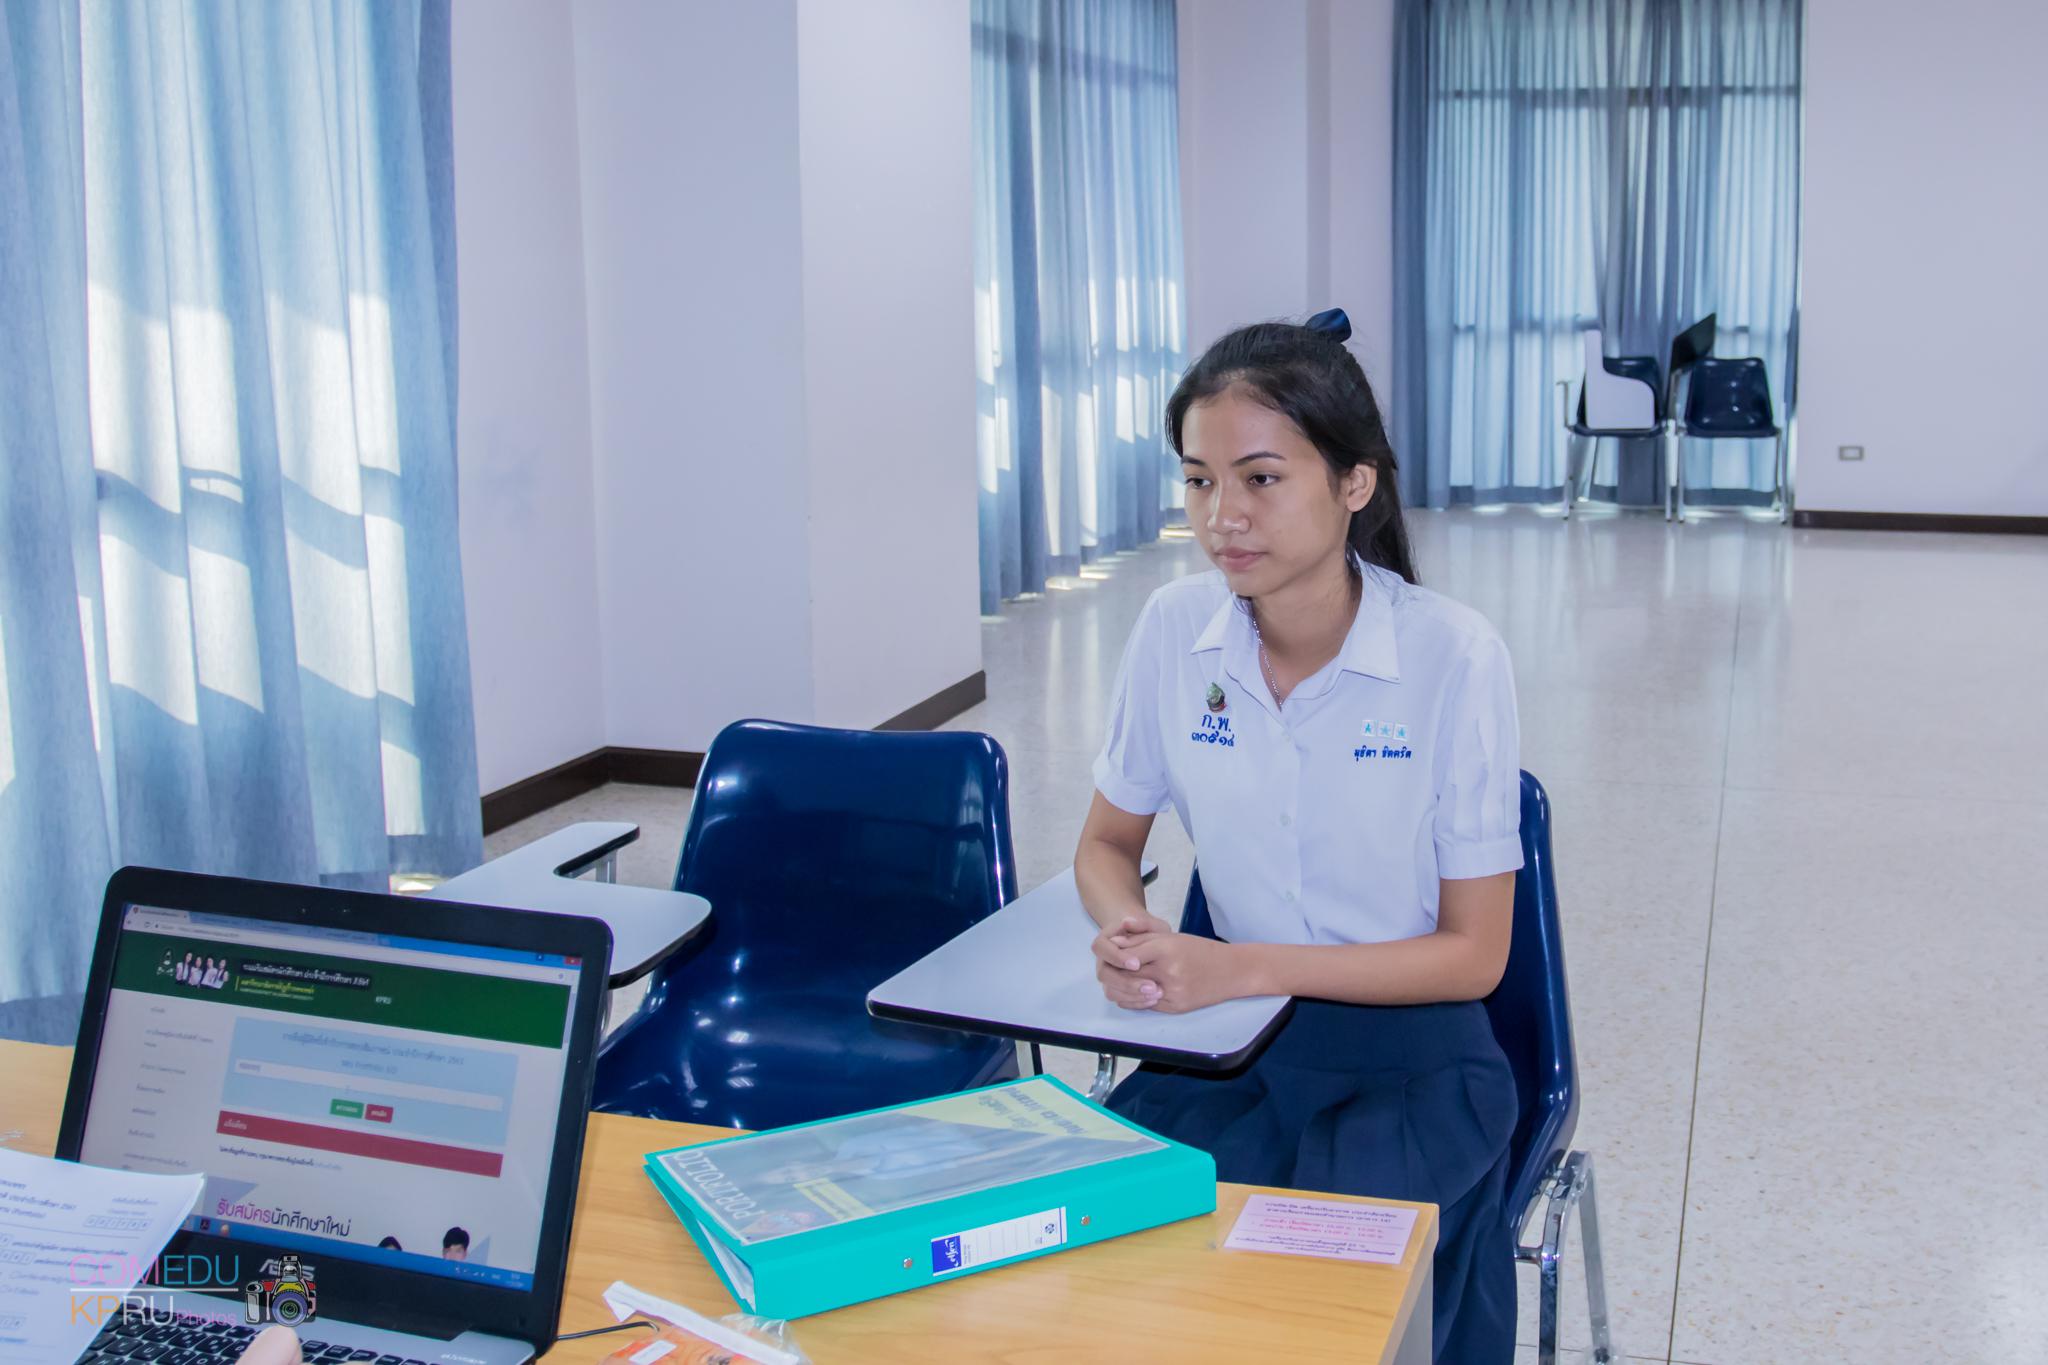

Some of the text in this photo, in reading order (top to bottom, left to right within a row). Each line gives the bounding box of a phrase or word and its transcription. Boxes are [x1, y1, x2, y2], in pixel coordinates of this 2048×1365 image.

[1202, 714, 1231, 732] ก.พ.
[673, 1151, 768, 1220] PORTFOLIO
[216, 1198, 352, 1237] รับสมัครนักศึกษาใหม่
[259, 1258, 315, 1281] ASS
